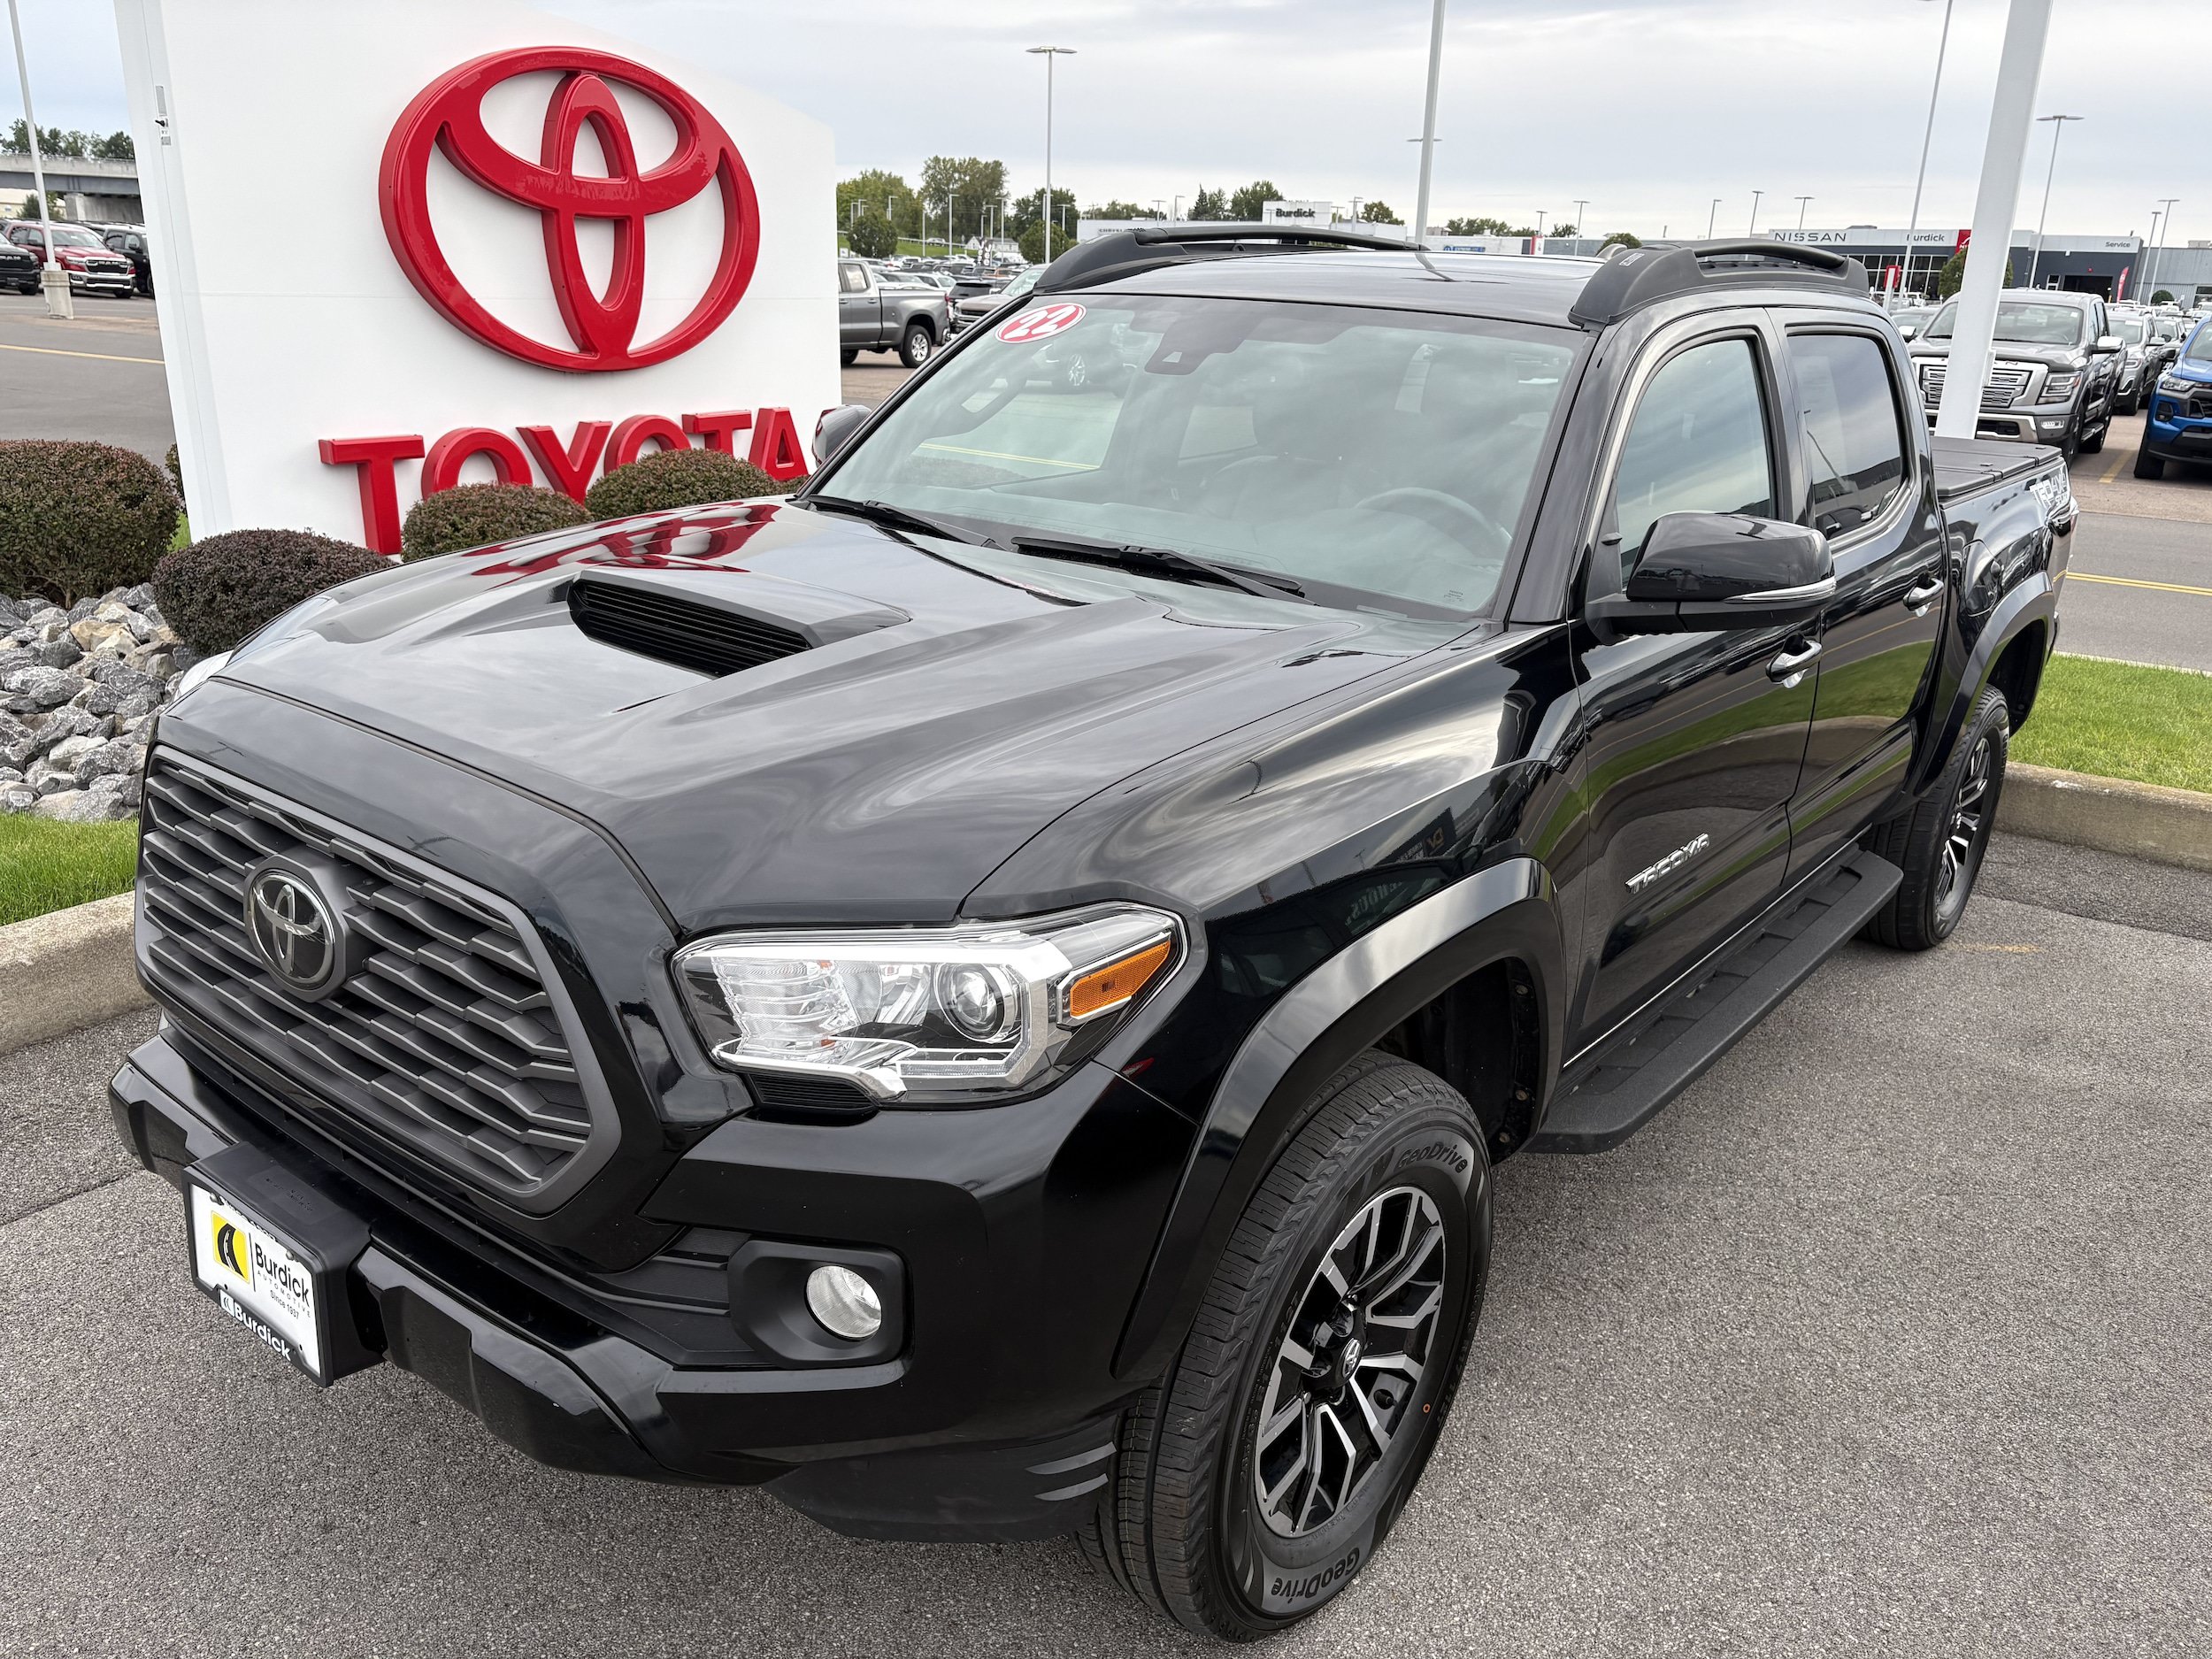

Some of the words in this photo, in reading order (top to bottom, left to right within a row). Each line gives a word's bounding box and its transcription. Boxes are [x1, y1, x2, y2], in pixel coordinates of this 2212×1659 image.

[1275, 208, 1316, 219] Burdick
[1773, 232, 1847, 242] NISSAN
[1004, 304, 1077, 340] 22
[319, 405, 809, 556] TOYOTA
[1624, 832, 1710, 895] TACOMA
[1394, 1141, 1469, 1174] GeoDrive
[254, 1241, 311, 1308] Burdick
[257, 1269, 311, 1318] AUTOMOTIVE
[270, 1288, 286, 1309] Since
[287, 1302, 300, 1320] 1937
[234, 1301, 292, 1362] Burdick
[1271, 1547, 1360, 1604] GeoDrive
